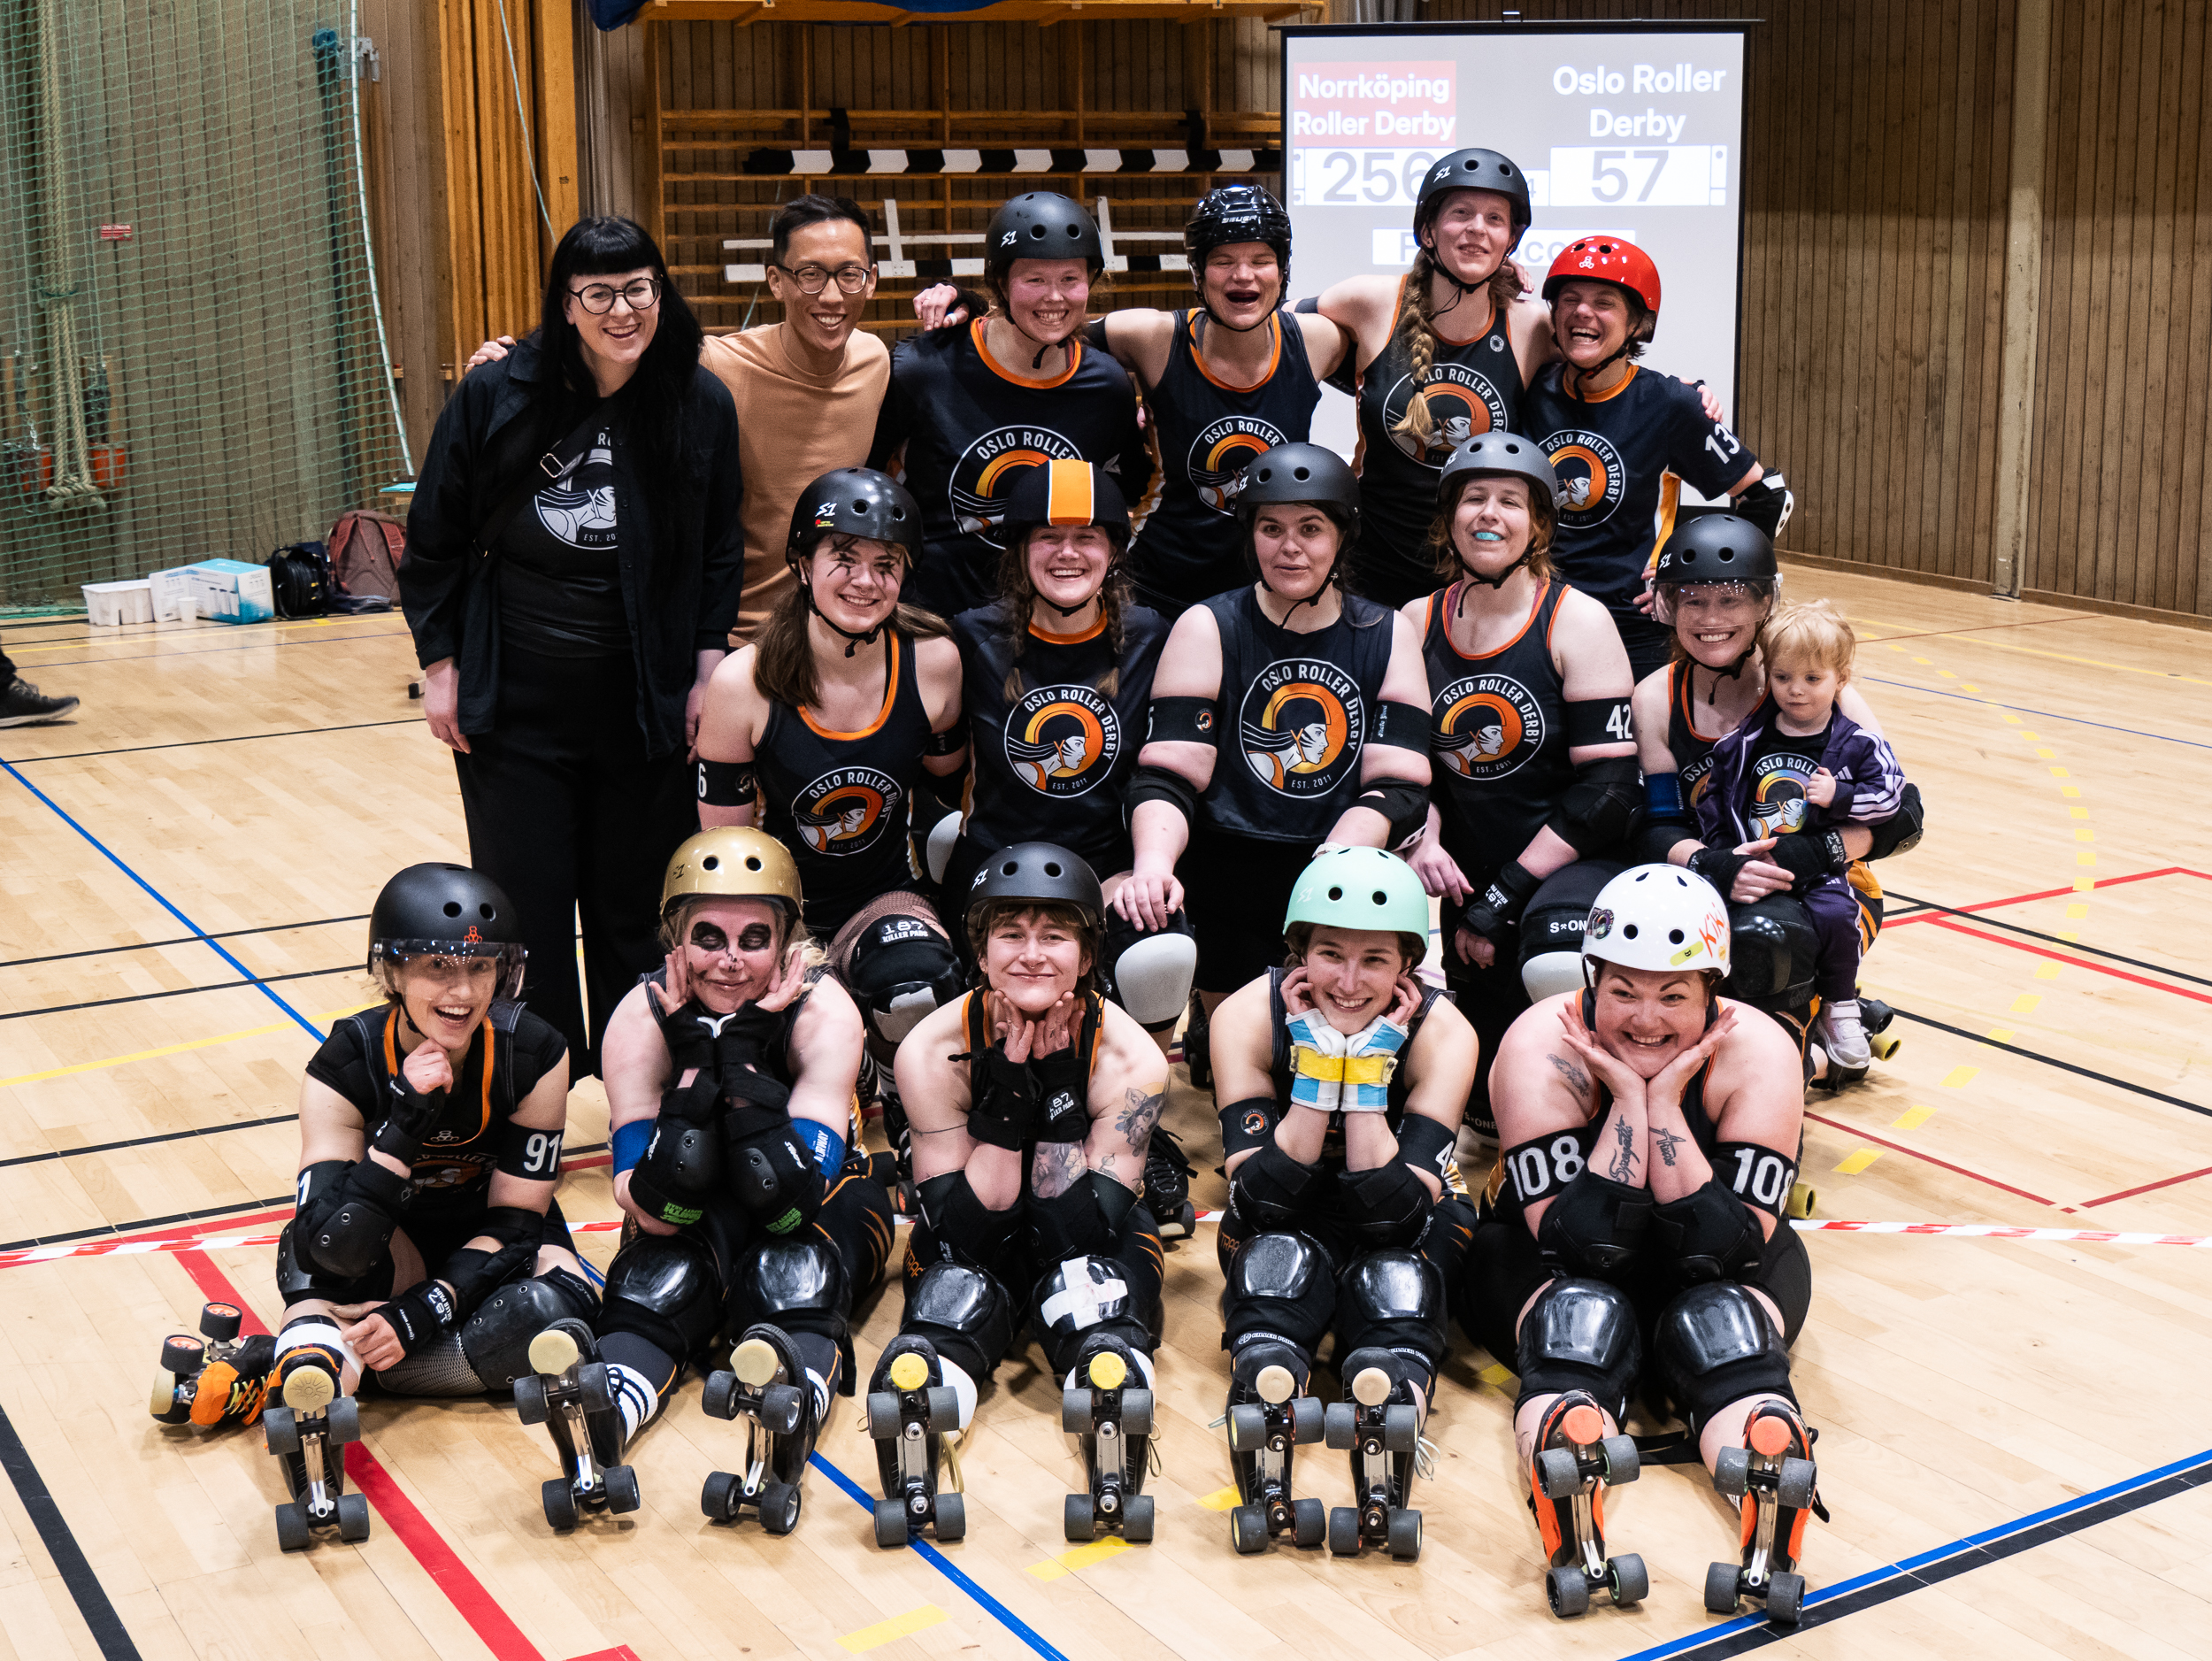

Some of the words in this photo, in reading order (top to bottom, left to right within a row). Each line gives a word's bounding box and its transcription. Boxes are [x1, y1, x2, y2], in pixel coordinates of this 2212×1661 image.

[1299, 73, 1449, 104] Norrköping
[1553, 65, 1624, 95] Oslo
[1632, 63, 1726, 94] Roller
[1293, 110, 1370, 136] Roller
[1374, 110, 1455, 142] Derby
[1590, 107, 1686, 143] Derby
[1323, 151, 1436, 203] 256
[1591, 150, 1670, 203] 57
[1000, 230, 1018, 248] S1
[1448, 367, 1493, 400] ROLLER
[976, 432, 1016, 460] OSLO
[1205, 421, 1233, 444] OSLO
[1238, 420, 1279, 447] ROLLER
[1705, 423, 1740, 464] 13
[1547, 434, 1573, 452] OSLO
[1577, 434, 1614, 462] ROLLER
[1605, 464, 1622, 504] DERBY
[815, 502, 837, 518] S1
[606, 533, 618, 542] 20
[1262, 665, 1293, 692] OSLO
[1298, 664, 1350, 698] ROLLER
[1024, 690, 1056, 712] OSLO
[1061, 689, 1105, 715] ROLLER
[1101, 715, 1118, 760] DERBY
[1443, 681, 1474, 705] OSLO
[1479, 679, 1524, 704] ROLLER
[1519, 703, 1540, 745] DERBY
[1606, 704, 1633, 739] 42
[1495, 760, 1512, 771] 2011
[1684, 756, 1715, 782] OSLO
[1755, 757, 1784, 777] OSLO
[1786, 757, 1819, 776] ROLL
[809, 774, 842, 798] OSLO
[847, 772, 892, 794] ROLLER
[1071, 777, 1087, 789] 2011
[1291, 780, 1310, 789] EST.
[1313, 774, 1333, 788] 2011
[881, 930, 909, 943] KILLER
[885, 920, 924, 935] 187
[524, 1134, 565, 1173] 91
[814, 1130, 829, 1163] NORWAY
[1506, 1135, 1585, 1202] 108
[1733, 1148, 1794, 1216] 108
[427, 1292, 448, 1323] 187
[434, 1287, 447, 1303] PADS
